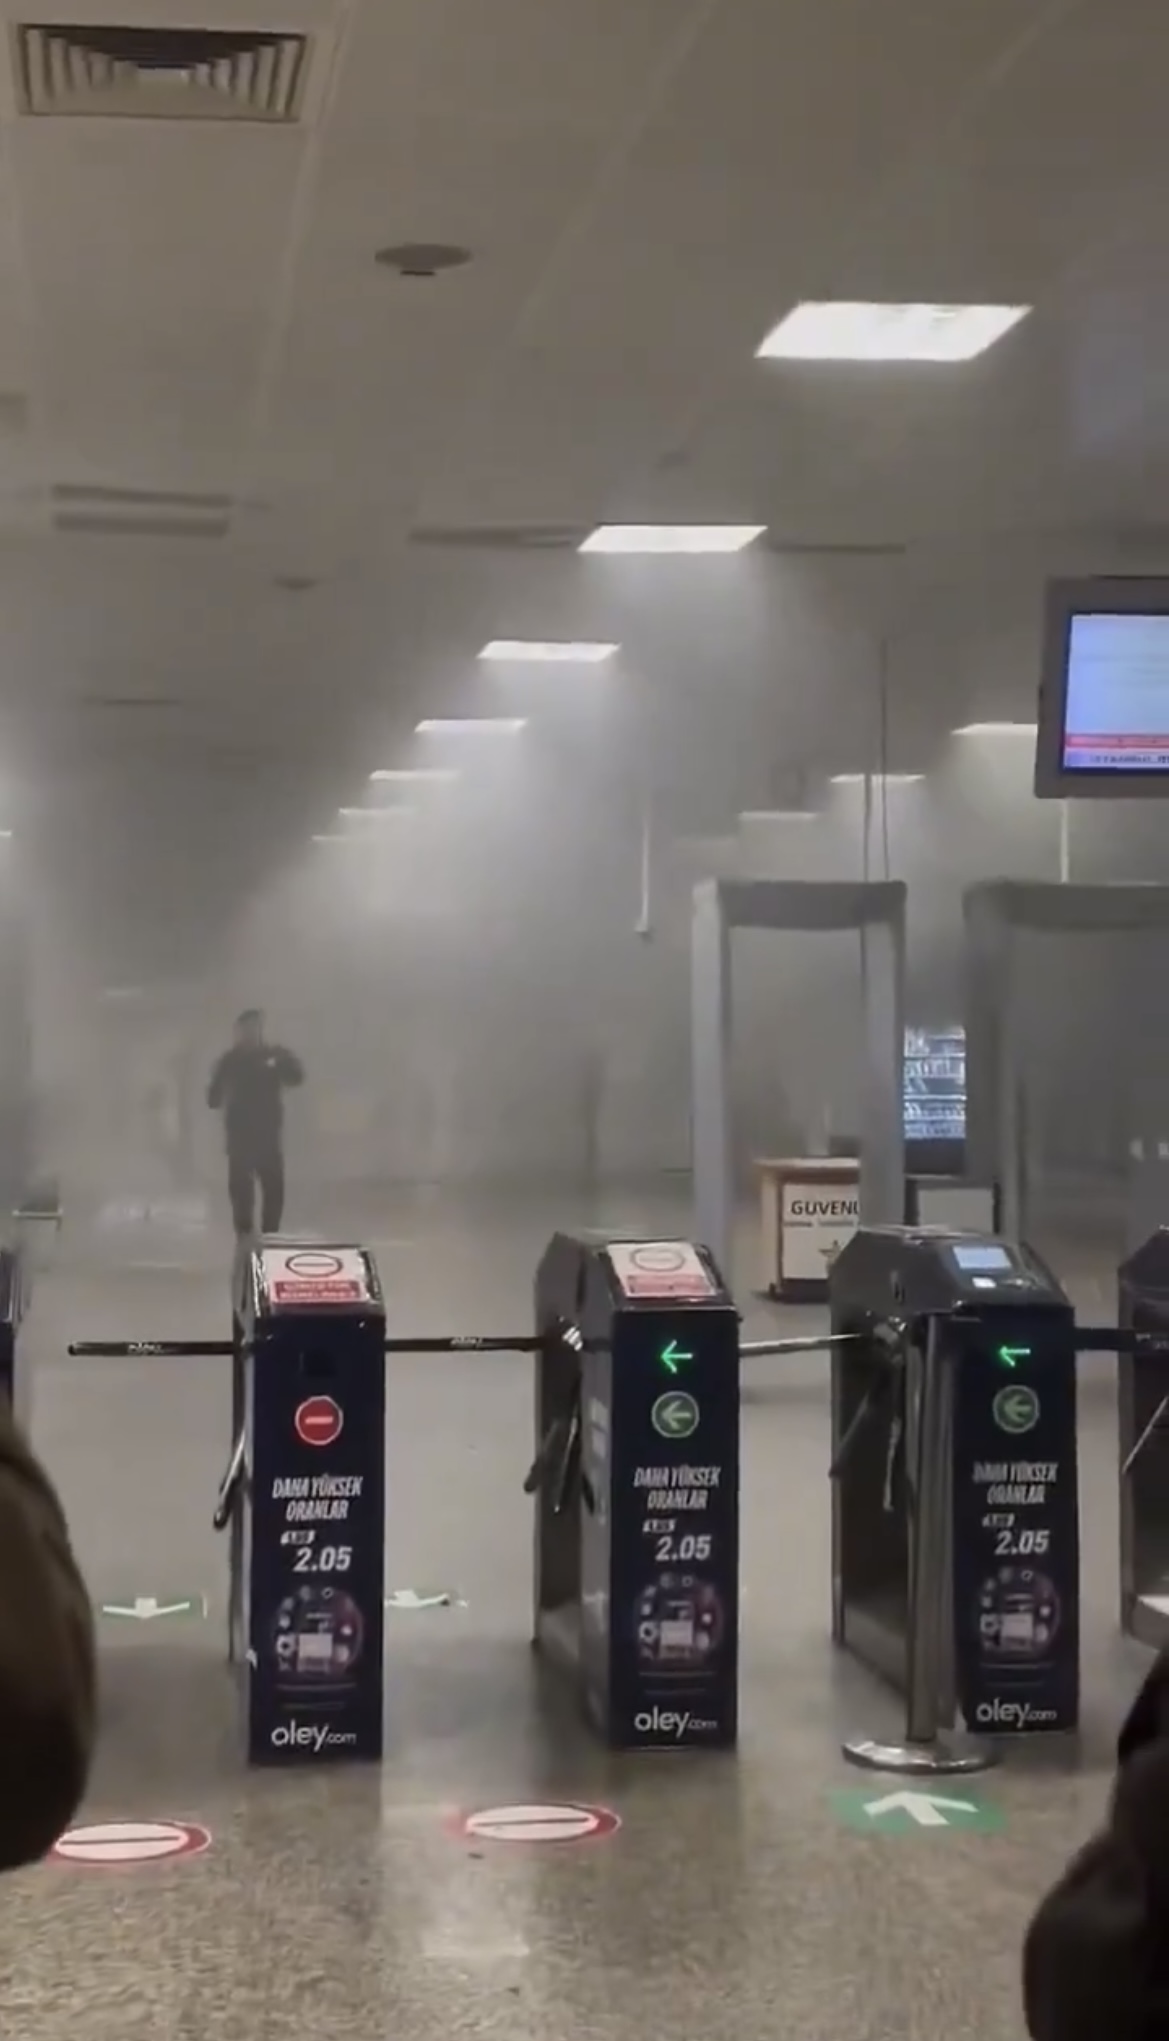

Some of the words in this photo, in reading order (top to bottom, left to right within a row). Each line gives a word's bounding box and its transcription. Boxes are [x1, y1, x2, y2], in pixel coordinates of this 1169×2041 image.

[271, 1476, 310, 1499] DAHA
[311, 1472, 364, 1498] YÜKSEK
[633, 1466, 669, 1488] DAHA
[285, 1499, 349, 1521] ORANLAR
[655, 1534, 712, 1561] 2.05
[994, 1529, 1051, 1556] 2.05
[292, 1545, 353, 1572] 2.05
